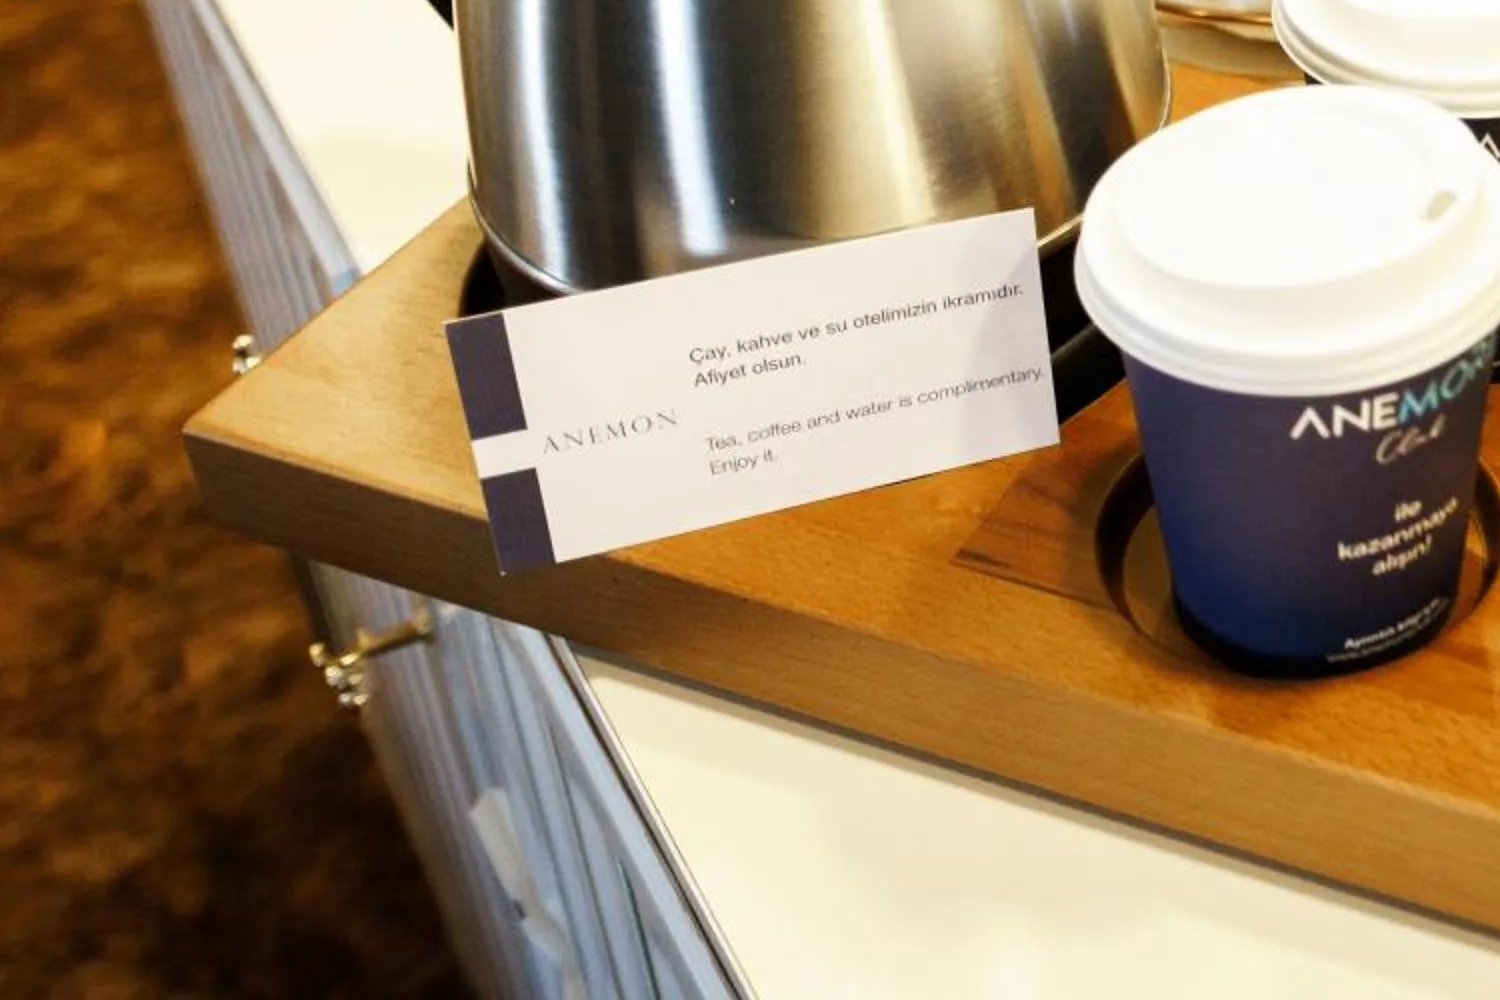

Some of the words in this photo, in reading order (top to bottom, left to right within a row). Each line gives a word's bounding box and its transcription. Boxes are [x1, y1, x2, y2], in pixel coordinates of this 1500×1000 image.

[737, 332, 793, 353] kahve
[798, 326, 820, 341] ve
[825, 320, 848, 336] su
[853, 300, 937, 329] otelimizin
[943, 283, 1024, 310] ikramıdır.
[694, 364, 748, 388] Afiyet
[752, 353, 806, 376] olsun.
[543, 408, 680, 454] ANEMON
[706, 435, 742, 453] Tea,
[748, 420, 802, 444] coffee
[807, 409, 841, 430] and
[846, 399, 893, 420] water
[899, 391, 912, 407] is
[917, 366, 1044, 405] complimentary.
[709, 453, 760, 476] Enjoy
